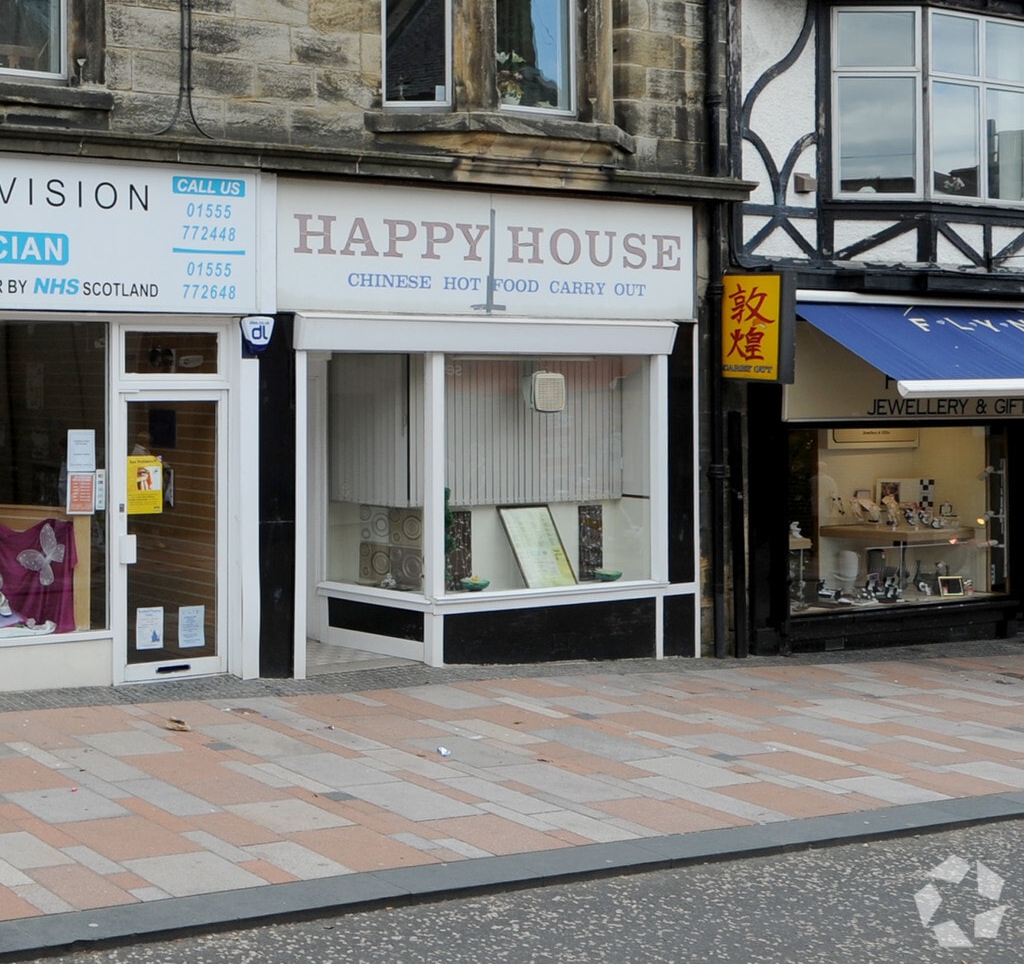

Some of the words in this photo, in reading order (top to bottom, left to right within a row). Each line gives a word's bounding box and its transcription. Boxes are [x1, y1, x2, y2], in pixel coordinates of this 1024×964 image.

[177, 177, 210, 195] CALL
[214, 179, 240, 195] US
[186, 202, 232, 220] 01555
[182, 225, 236, 243] 772448
[293, 213, 490, 262] HAPPY
[507, 225, 682, 271] HOUSE
[186, 261, 232, 277] 01555
[7, 278, 27, 294] BY
[33, 278, 79, 295] NHS
[82, 280, 159, 298] SCOTLAND
[182, 283, 236, 300] 772648
[347, 272, 432, 290] CHINESE
[443, 275, 482, 291] HOT
[493, 277, 539, 293] FOOD
[549, 280, 606, 296] CARRY
[613, 282, 647, 297] OUT
[727, 283, 775, 361] 敦煌
[867, 398, 969, 416] JEWELLERY
[975, 399, 987, 415] &
